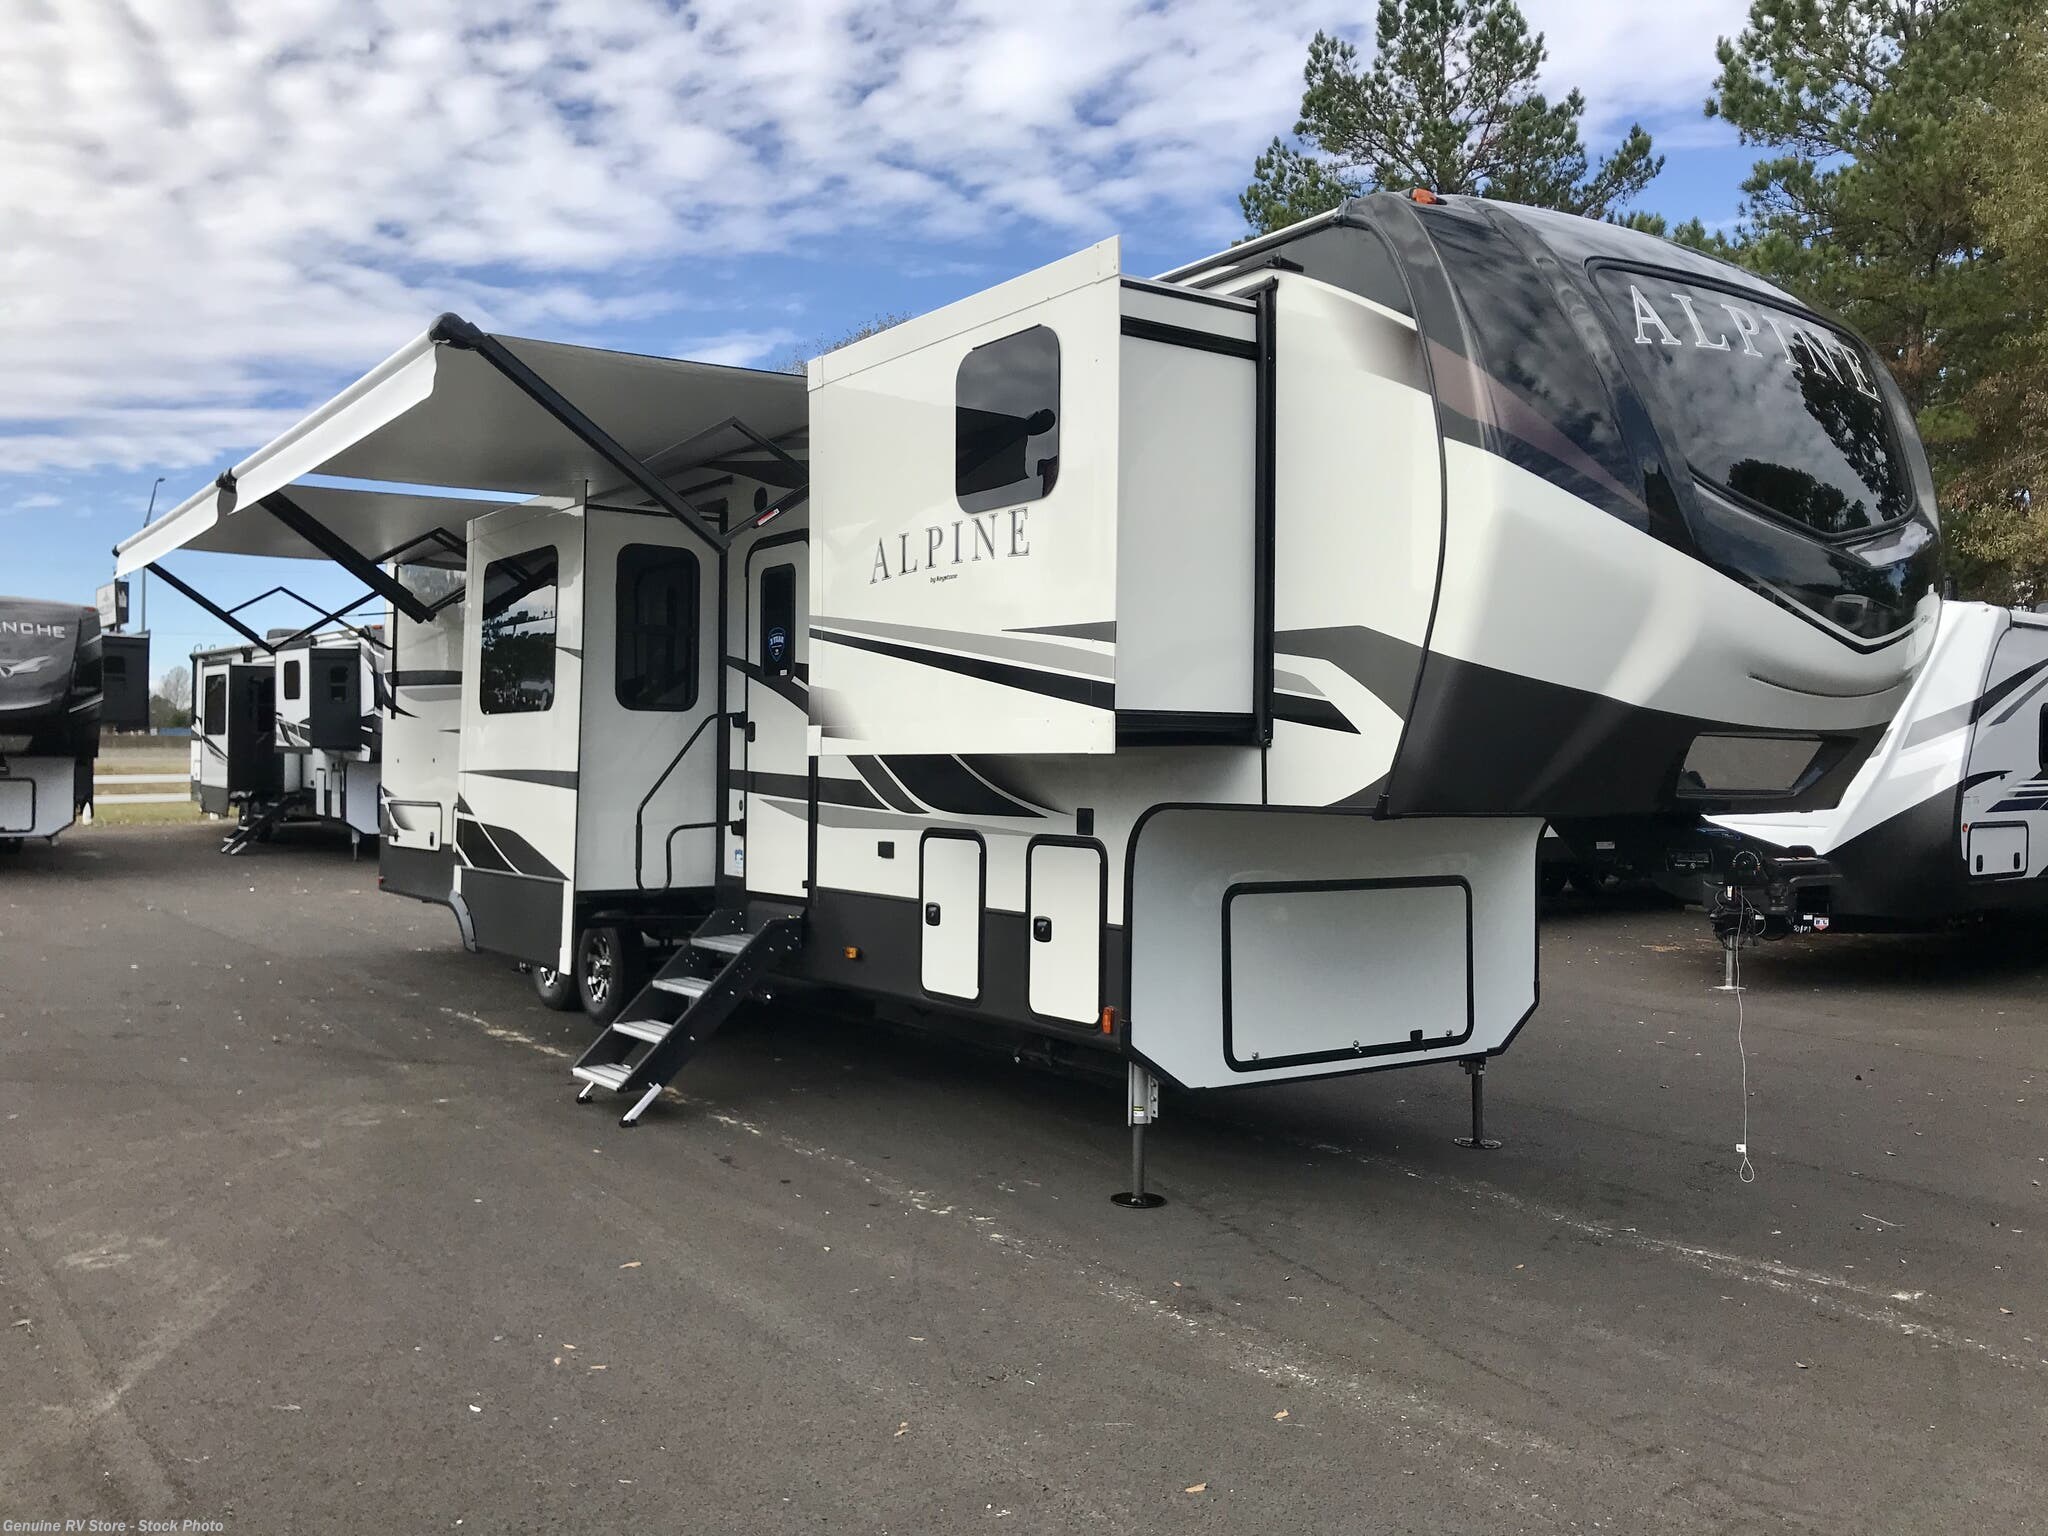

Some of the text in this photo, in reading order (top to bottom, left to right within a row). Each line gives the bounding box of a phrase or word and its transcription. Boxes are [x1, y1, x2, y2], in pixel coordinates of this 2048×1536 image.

[1630, 285, 1881, 403] ALPINE
[869, 506, 1030, 584] ALPINE
[0, 621, 66, 639] NCHE
